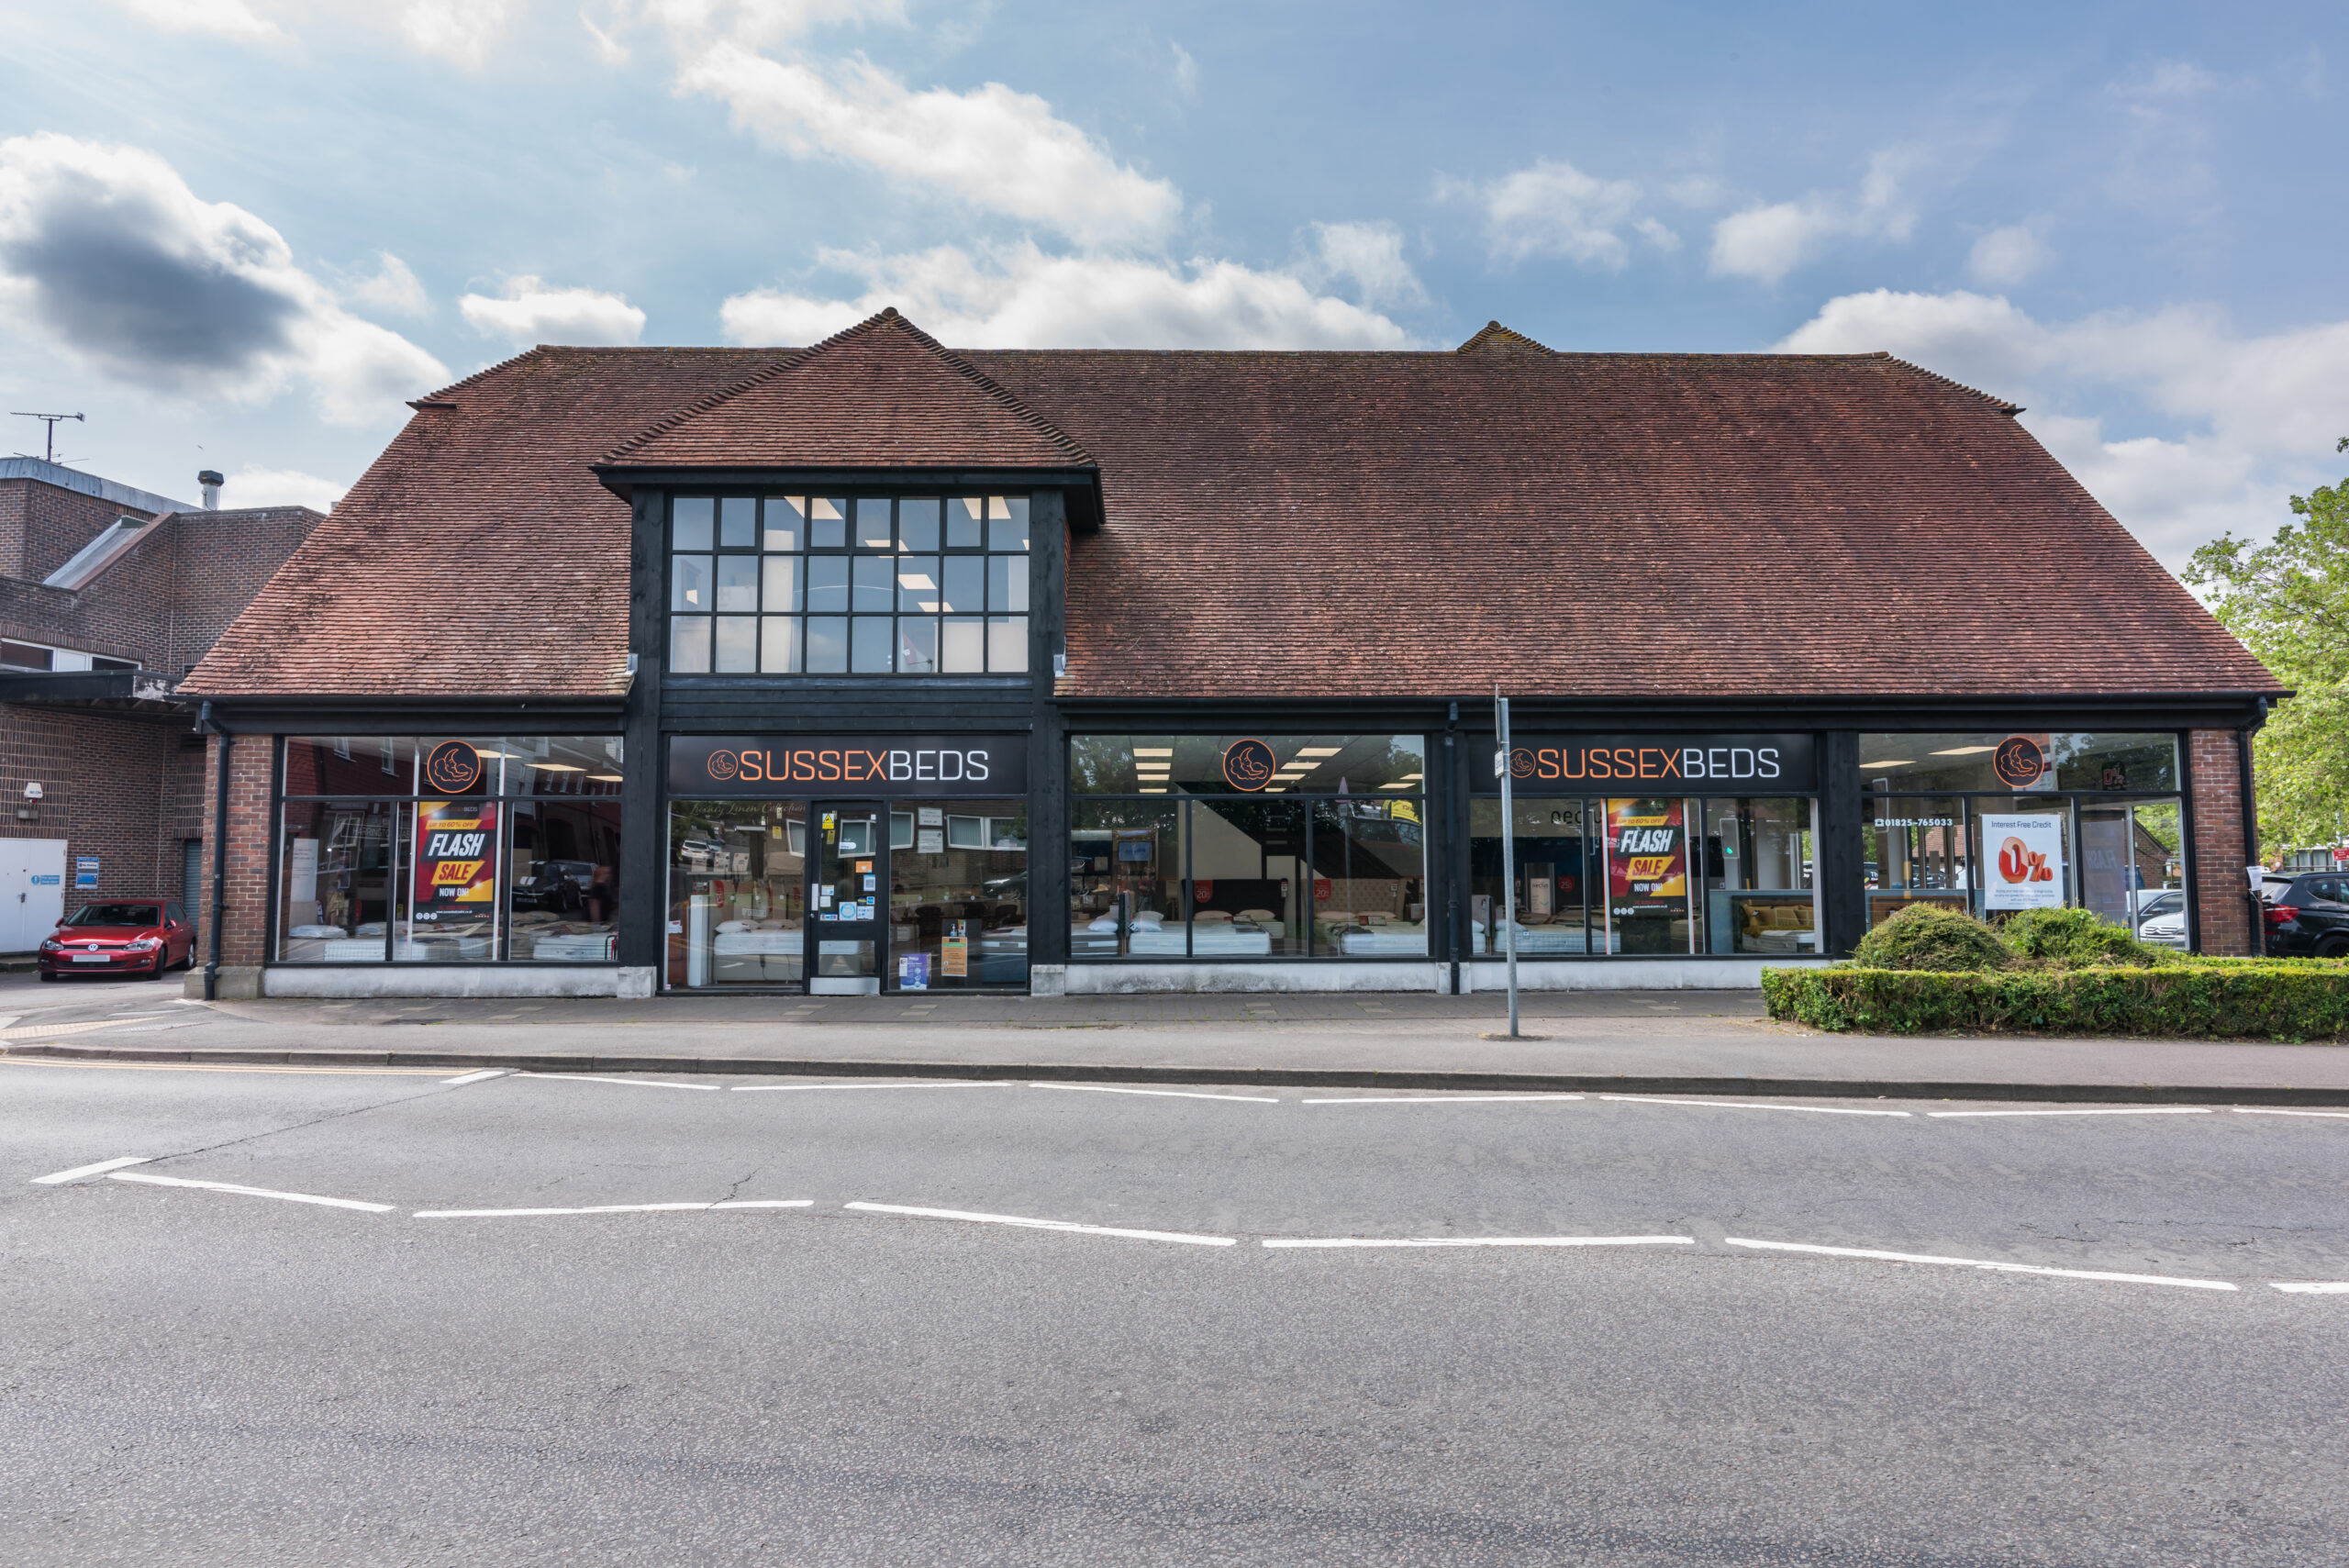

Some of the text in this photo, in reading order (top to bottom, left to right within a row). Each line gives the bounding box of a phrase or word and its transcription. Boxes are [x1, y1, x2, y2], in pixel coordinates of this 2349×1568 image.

[739, 750, 990, 782] SUSSEXBEDS
[1537, 748, 1781, 779] SUSSEXBEDS
[1885, 818, 1954, 827] 01825-765033
[1991, 820, 2052, 828] Interest Free Credit
[428, 833, 486, 857] FLASH
[1620, 829, 1674, 853] FLASH
[1633, 859, 1664, 876] SALE
[1998, 836, 2054, 884] 0%
[438, 863, 473, 881] SALE
[439, 887, 470, 897] NOW ON!
[1633, 883, 1663, 893] NOW ON!
